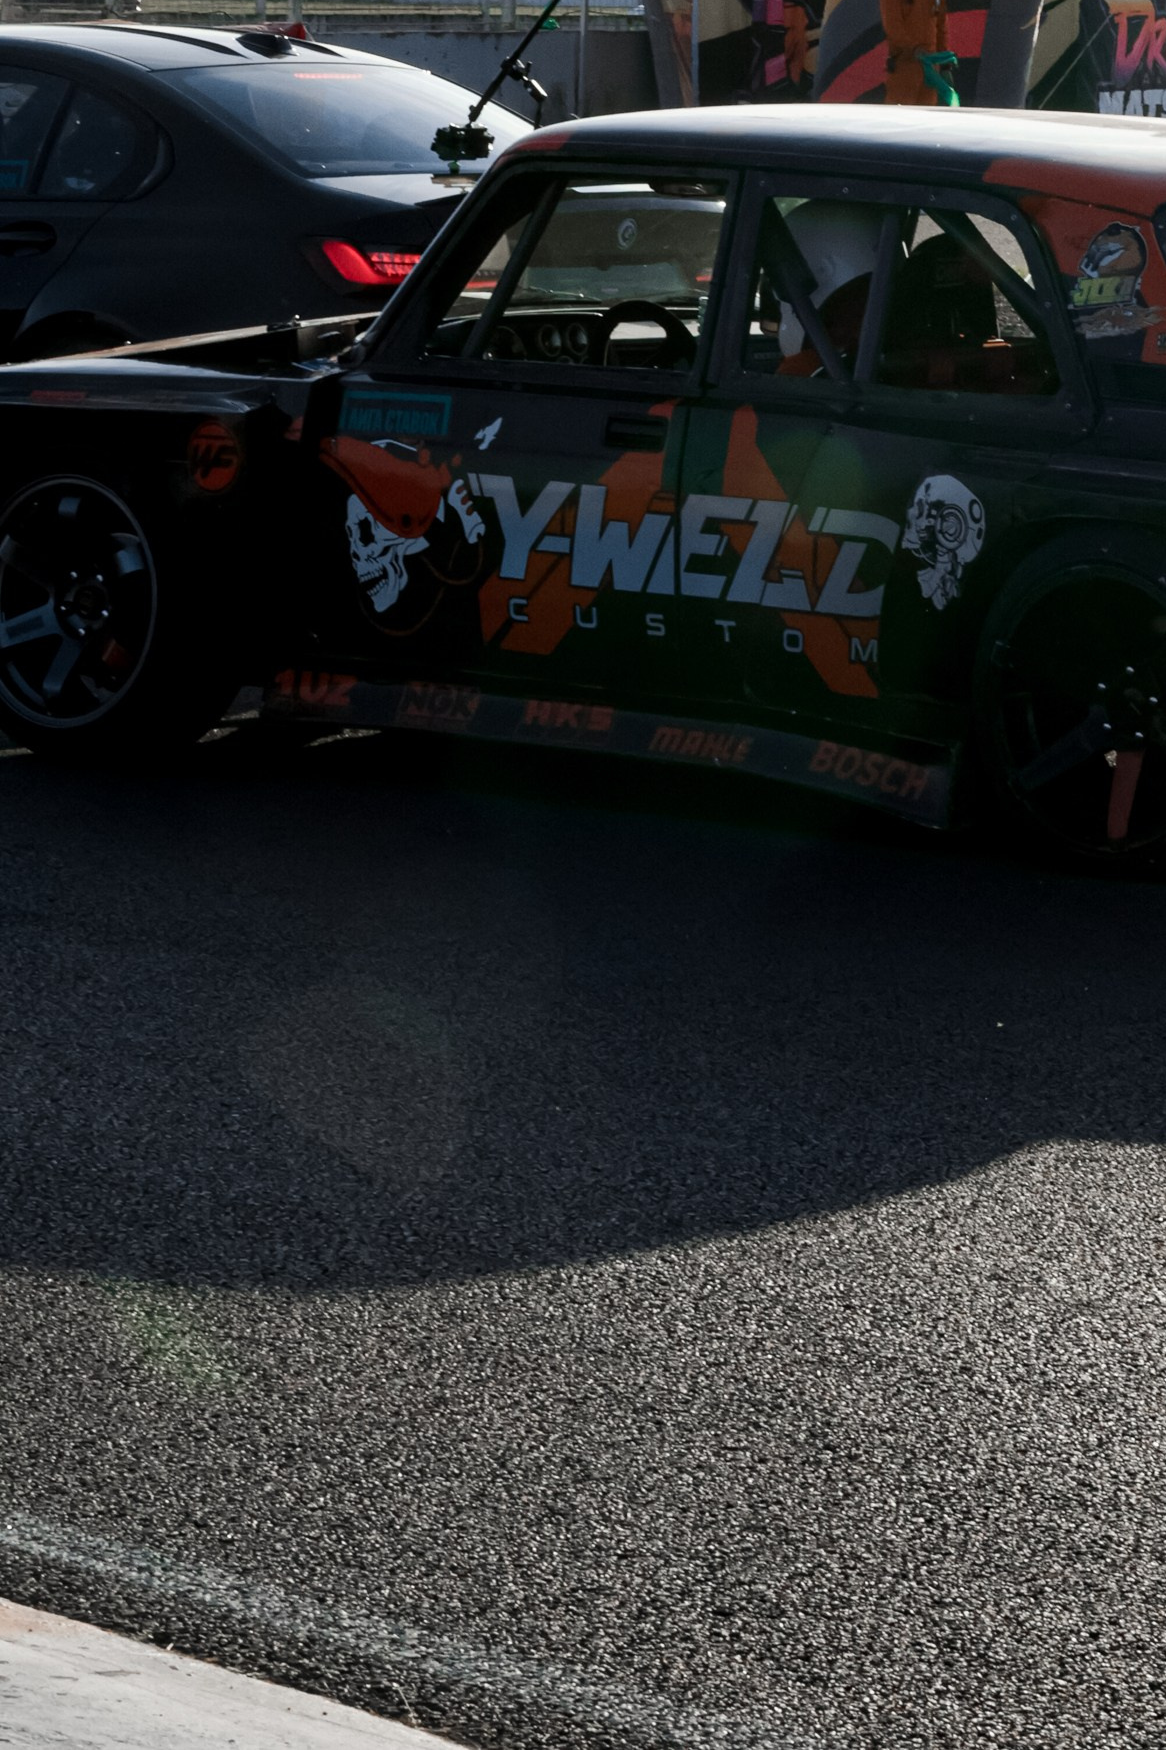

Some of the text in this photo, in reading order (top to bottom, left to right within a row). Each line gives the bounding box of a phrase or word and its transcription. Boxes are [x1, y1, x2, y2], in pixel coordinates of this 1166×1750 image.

[467, 471, 901, 619] Y-WELD
[508, 597, 879, 664] CUSTOM
[274, 668, 360, 707] 1UZ
[523, 698, 614, 733] HKS
[647, 724, 755, 764] MAHLE
[808, 740, 932, 801] BOSCH
